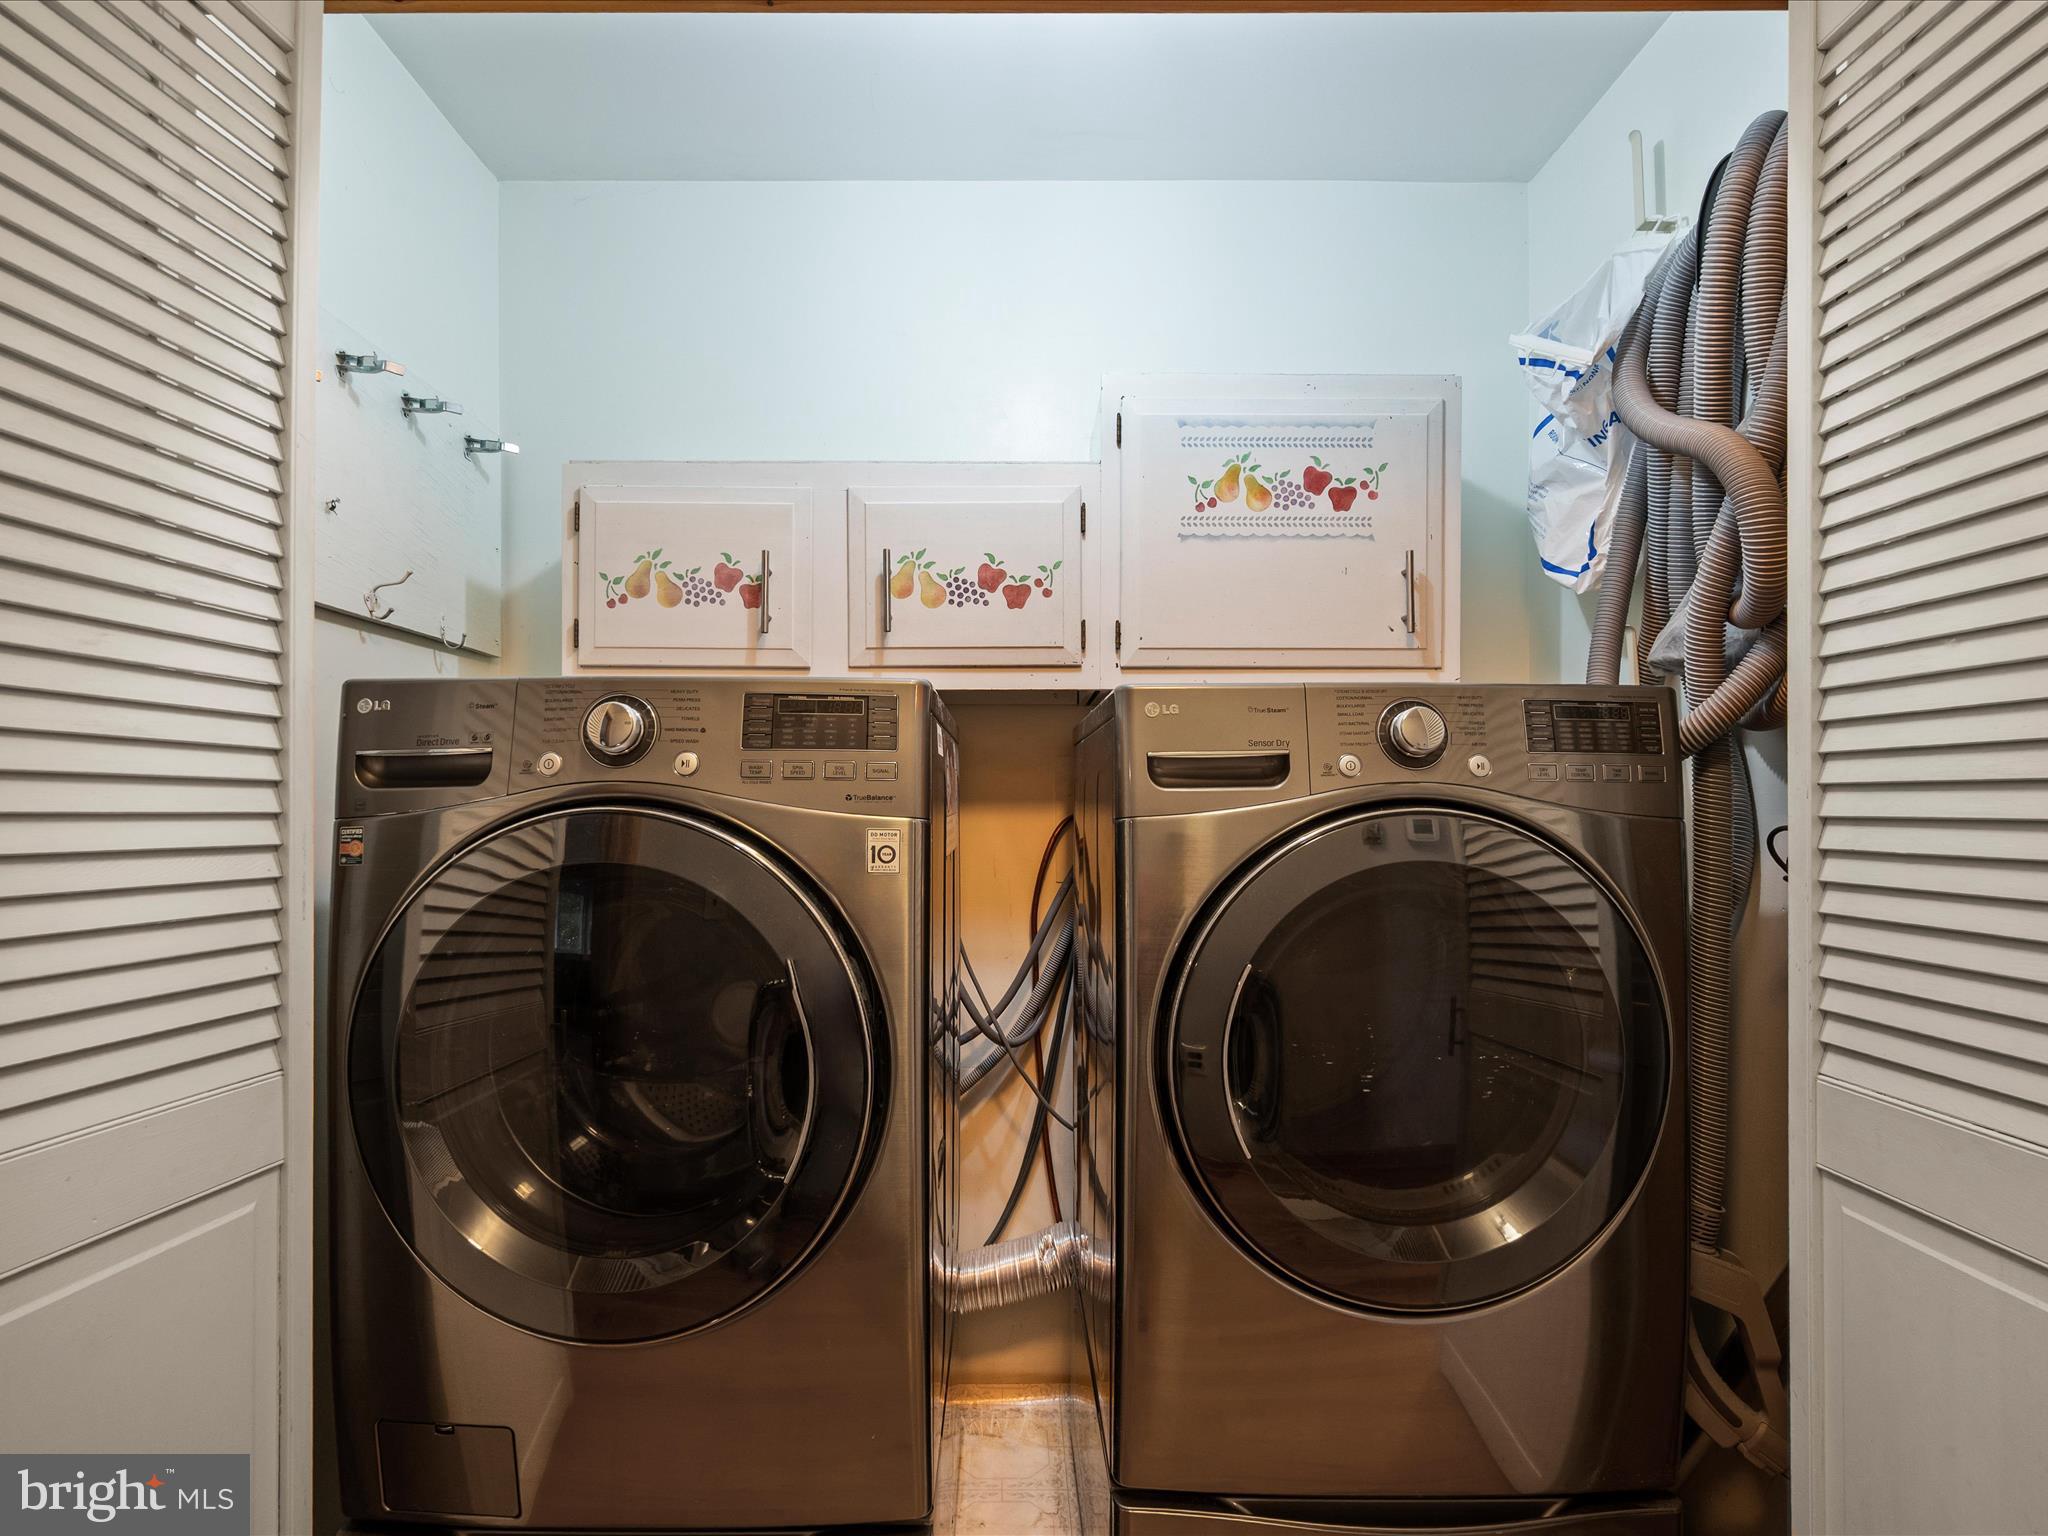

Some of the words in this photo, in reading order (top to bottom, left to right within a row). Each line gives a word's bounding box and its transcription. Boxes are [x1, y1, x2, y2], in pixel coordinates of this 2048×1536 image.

[1162, 704, 1179, 715] LG
[416, 738, 439, 747] Direct
[439, 737, 460, 746] Drive
[1248, 739, 1275, 748] Sensor
[1275, 739, 1290, 749] Dry
[853, 794, 893, 802] TrueBalance
[870, 845, 897, 865] 10
